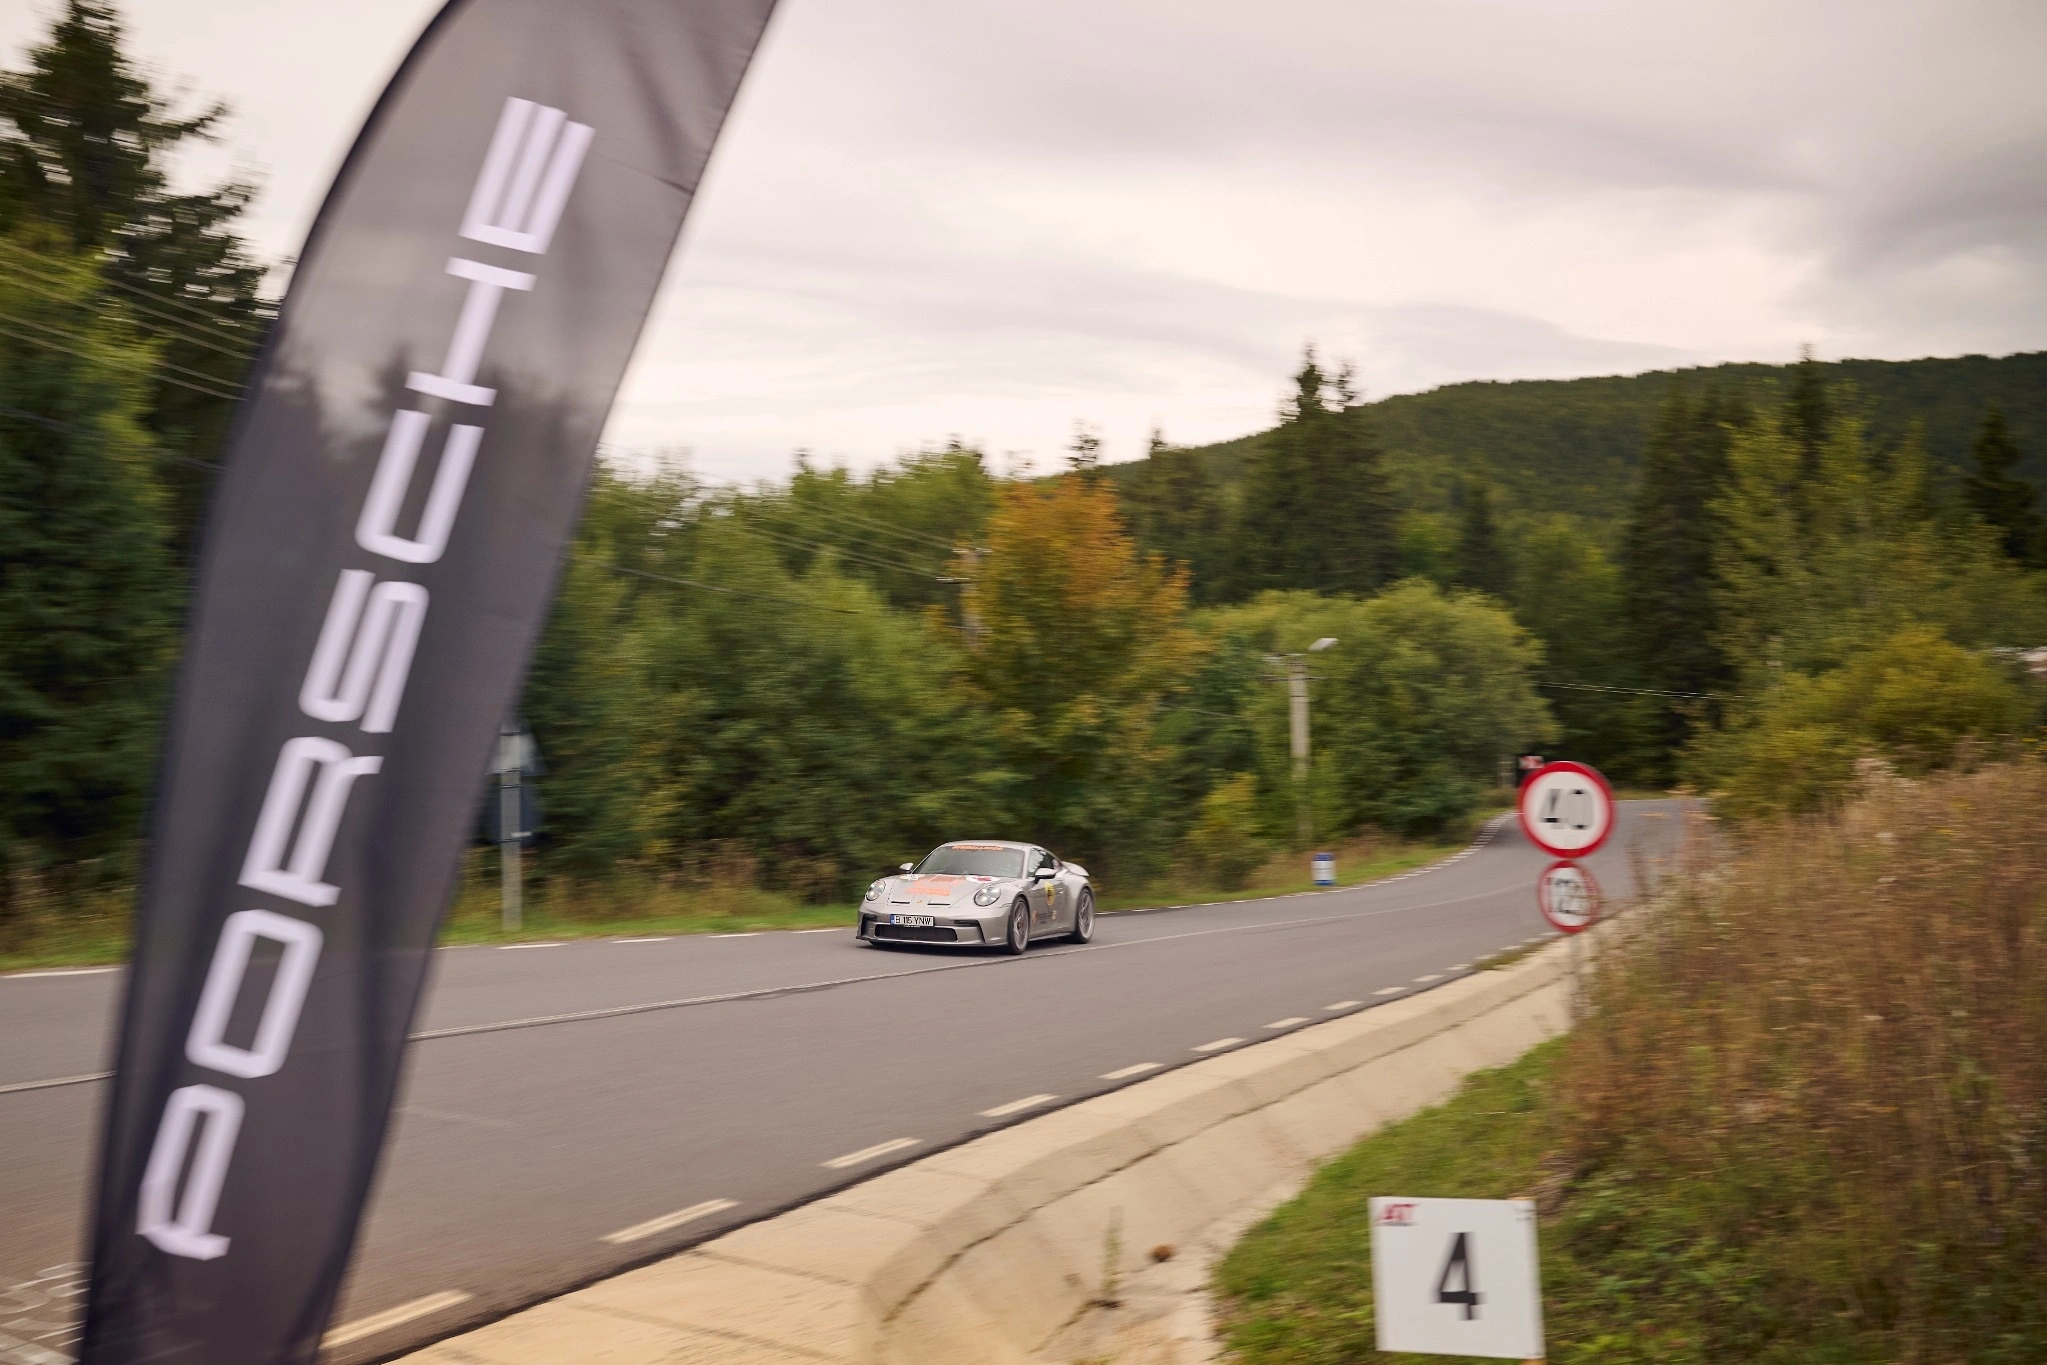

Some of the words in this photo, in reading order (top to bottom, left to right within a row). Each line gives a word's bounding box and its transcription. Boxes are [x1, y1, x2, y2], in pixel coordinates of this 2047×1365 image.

[137, 97, 595, 1261] PORSCHE
[1540, 788, 1594, 830] 40
[895, 916, 901, 924] B
[914, 917, 931, 925] YNW
[1433, 1232, 1485, 1321] 4
